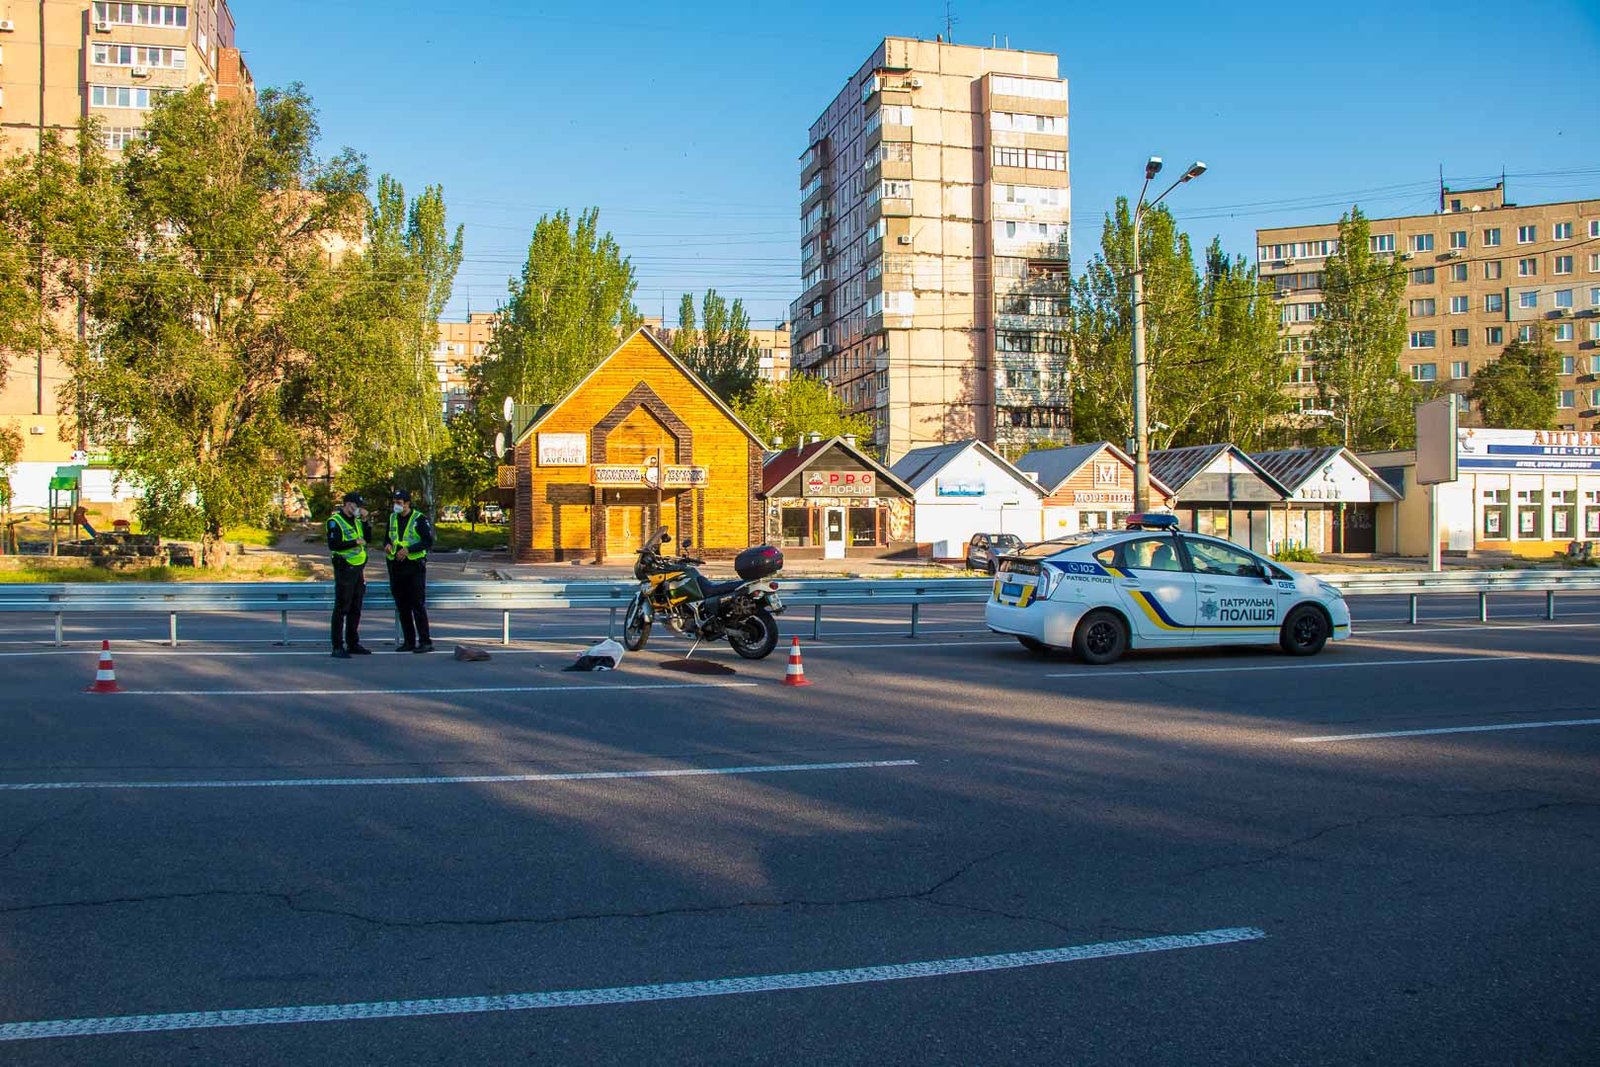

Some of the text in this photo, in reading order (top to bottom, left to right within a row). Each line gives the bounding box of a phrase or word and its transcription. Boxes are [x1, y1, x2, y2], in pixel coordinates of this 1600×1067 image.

[829, 473, 872, 484] PRO
[1098, 464, 1116, 484] М
[829, 485, 872, 494] ПОРЦІЯ
[1075, 493, 1134, 503] МОРЕ ПИВ
[1079, 564, 1096, 573] 102
[1066, 575, 1089, 583] PATROL
[1220, 598, 1275, 607] ПАТРУЛЬНА
[1220, 608, 1275, 621] ПОЛІЦІЯ
